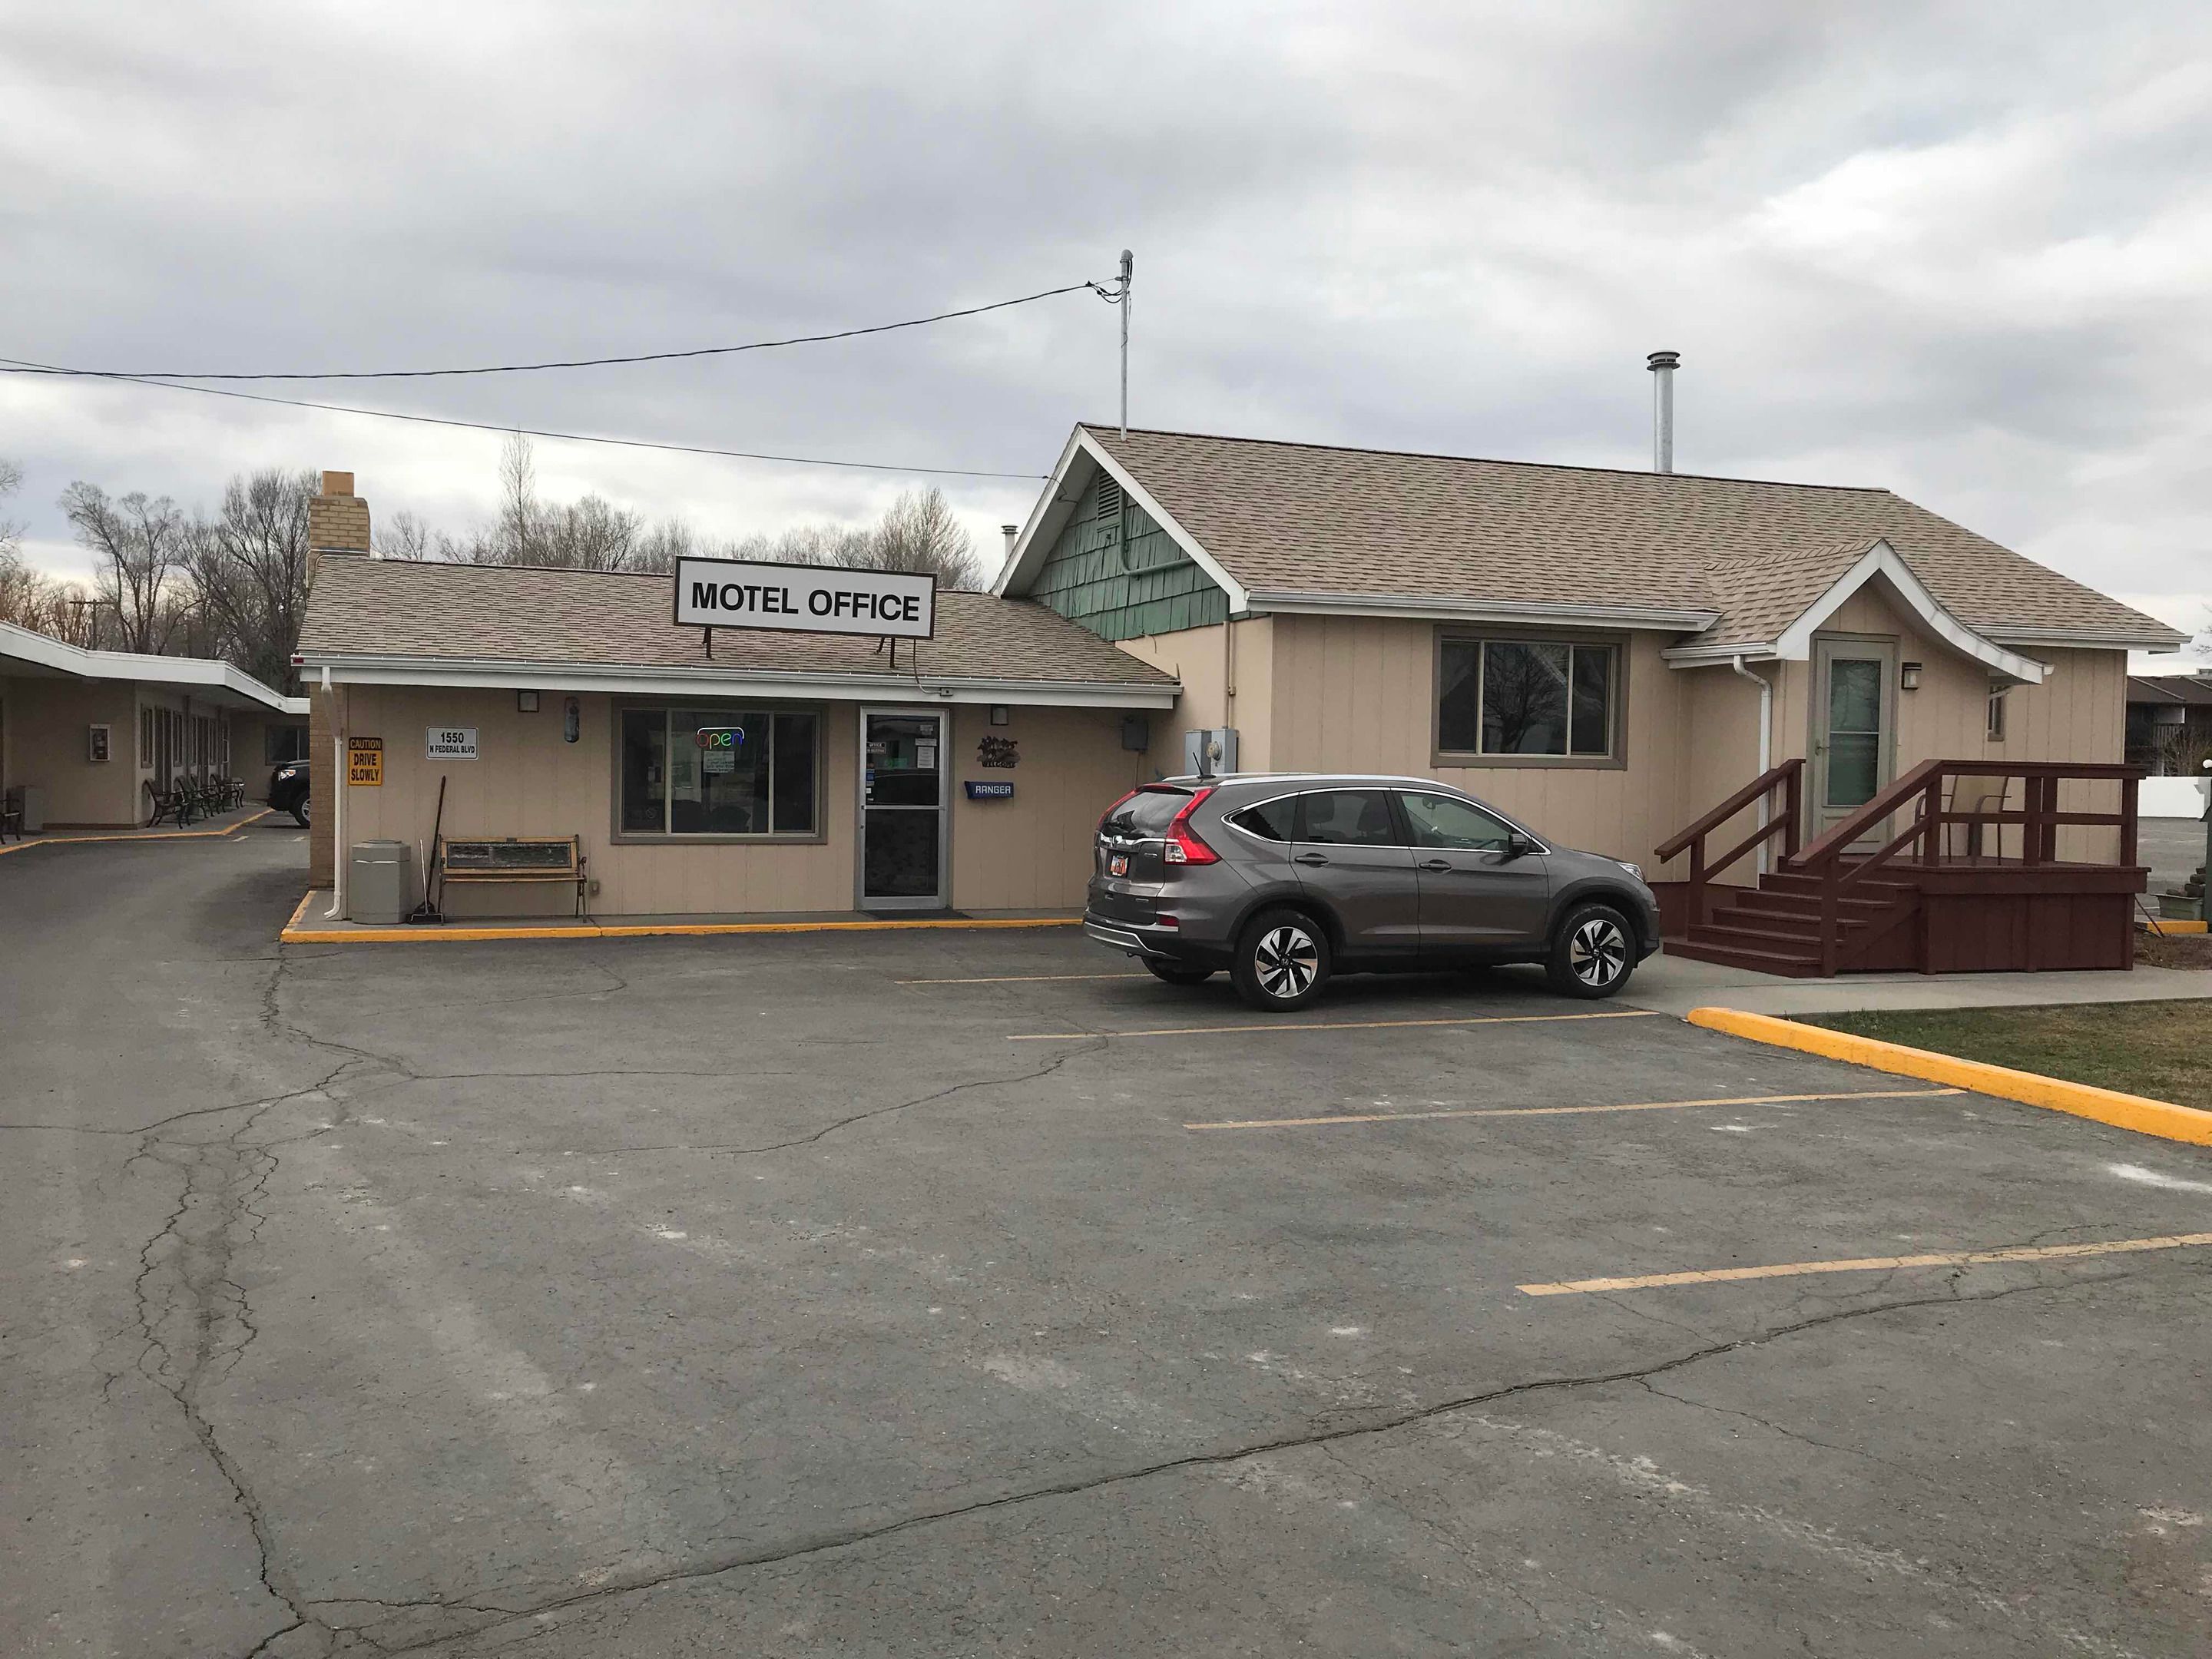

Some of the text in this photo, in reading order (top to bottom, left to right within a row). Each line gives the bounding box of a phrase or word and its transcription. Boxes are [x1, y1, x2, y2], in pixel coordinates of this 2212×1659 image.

[691, 582, 920, 621] MOTEL OFFICE
[441, 732, 464, 743] 1550
[350, 739, 381, 748] CAUTION
[435, 745, 459, 753] FEDERAL
[461, 745, 475, 753] BLVD
[354, 753, 376, 766] DRIVE
[351, 769, 379, 781] SLOWLY
[975, 786, 1011, 794] RANGER
